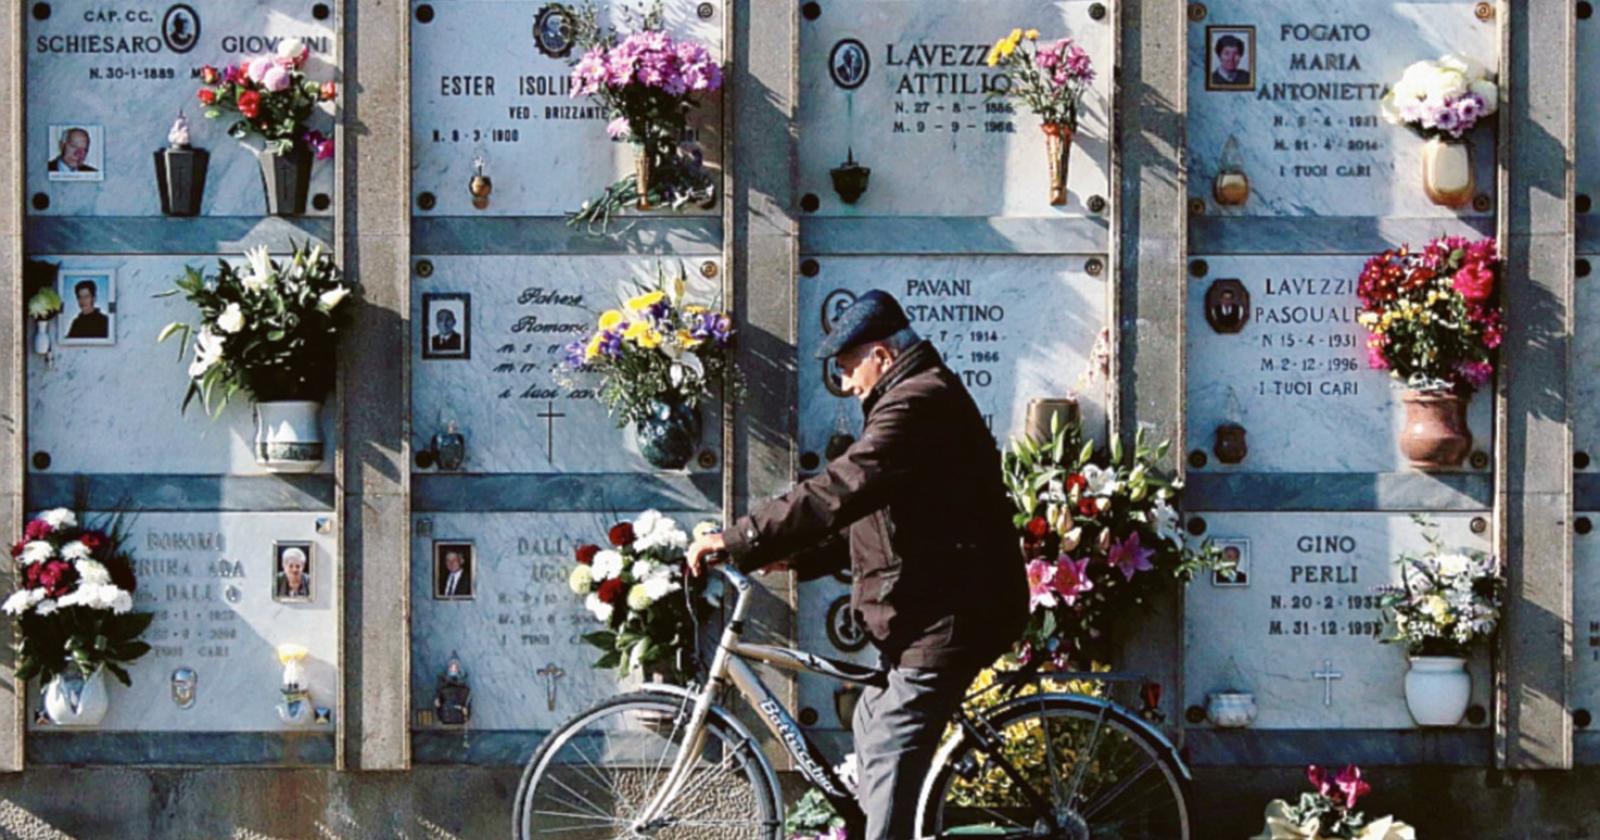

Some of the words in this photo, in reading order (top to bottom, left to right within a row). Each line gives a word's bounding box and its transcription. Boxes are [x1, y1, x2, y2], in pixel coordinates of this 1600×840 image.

[84, 11, 120, 22] CAP.
[126, 11, 153, 22] CC.
[1280, 24, 1370, 41] FOGATO
[37, 35, 162, 53] SCHIESARO
[221, 36, 327, 53] GIOVNI
[886, 44, 1010, 66] LAVEZZ
[1290, 54, 1361, 70] MARIA
[89, 68, 103, 79] N.
[441, 75, 495, 96] ESTER
[896, 74, 1012, 94] ATTILIO
[1257, 83, 1390, 100] ANTONIETTA
[894, 102, 909, 114] N.
[914, 102, 930, 114] 27
[893, 121, 910, 133] M.
[1294, 165, 1327, 177] TUOI
[1336, 165, 1371, 177] CARI
[906, 280, 971, 296] PAVANI
[1266, 279, 1353, 295] LAVEZZI
[904, 305, 1004, 322] STANTINO
[1256, 307, 1362, 323] PASQUALE
[1273, 381, 1312, 395] TUOI
[1320, 381, 1358, 395] CARI
[1297, 536, 1356, 553] GINO
[1291, 566, 1358, 583] PERLI
[1270, 595, 1286, 609] N.
[1269, 621, 1288, 635] M.
